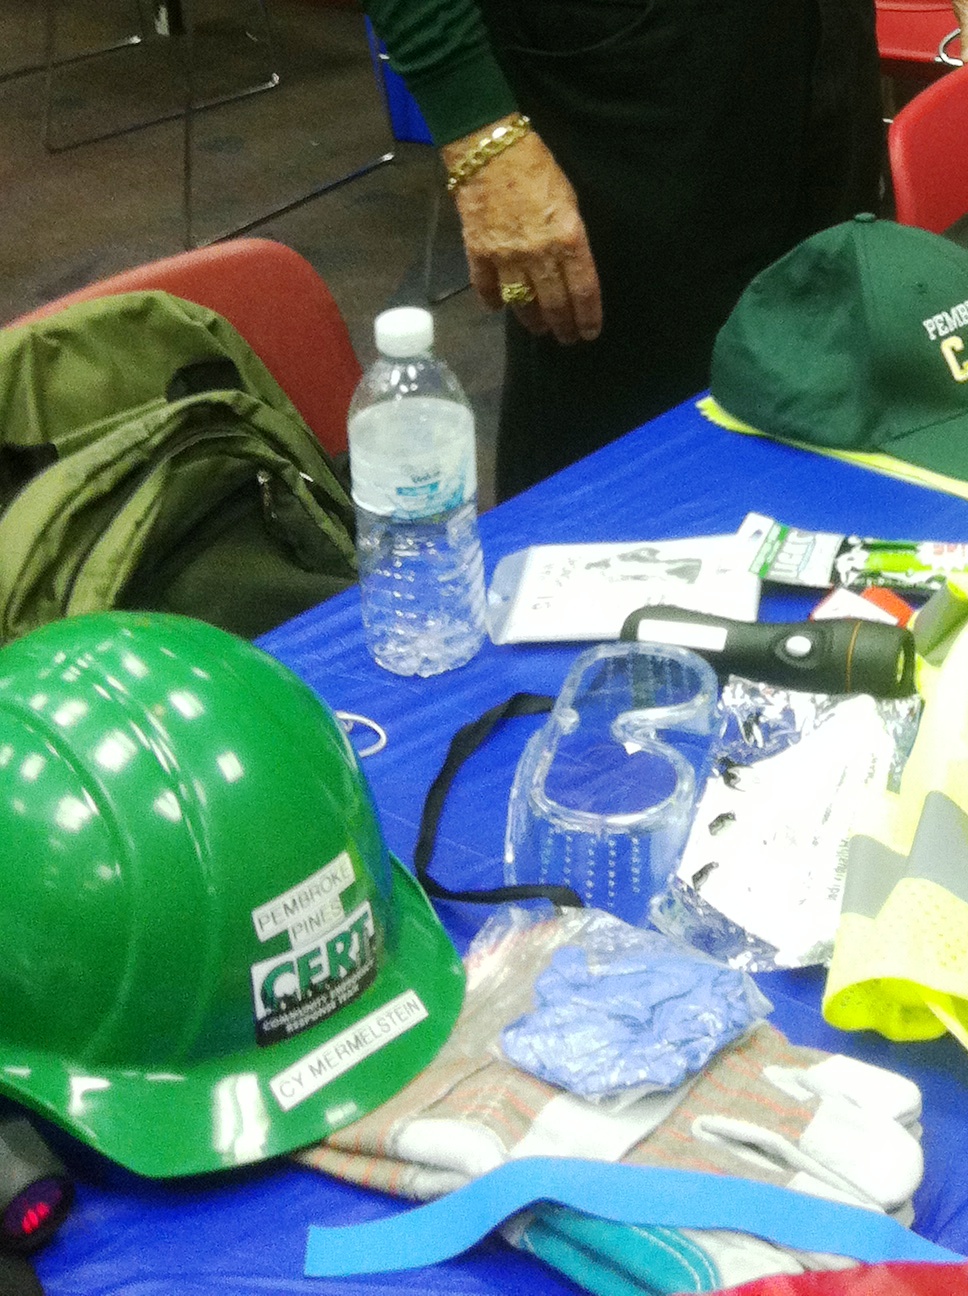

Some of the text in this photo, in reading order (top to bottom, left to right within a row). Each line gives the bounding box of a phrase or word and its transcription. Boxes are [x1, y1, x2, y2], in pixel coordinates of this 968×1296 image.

[257, 863, 351, 933] PEMBROKE
[290, 901, 344, 942] PINES
[260, 910, 372, 1010] CERT
[279, 997, 421, 1099] CY MERMELSTEIN
